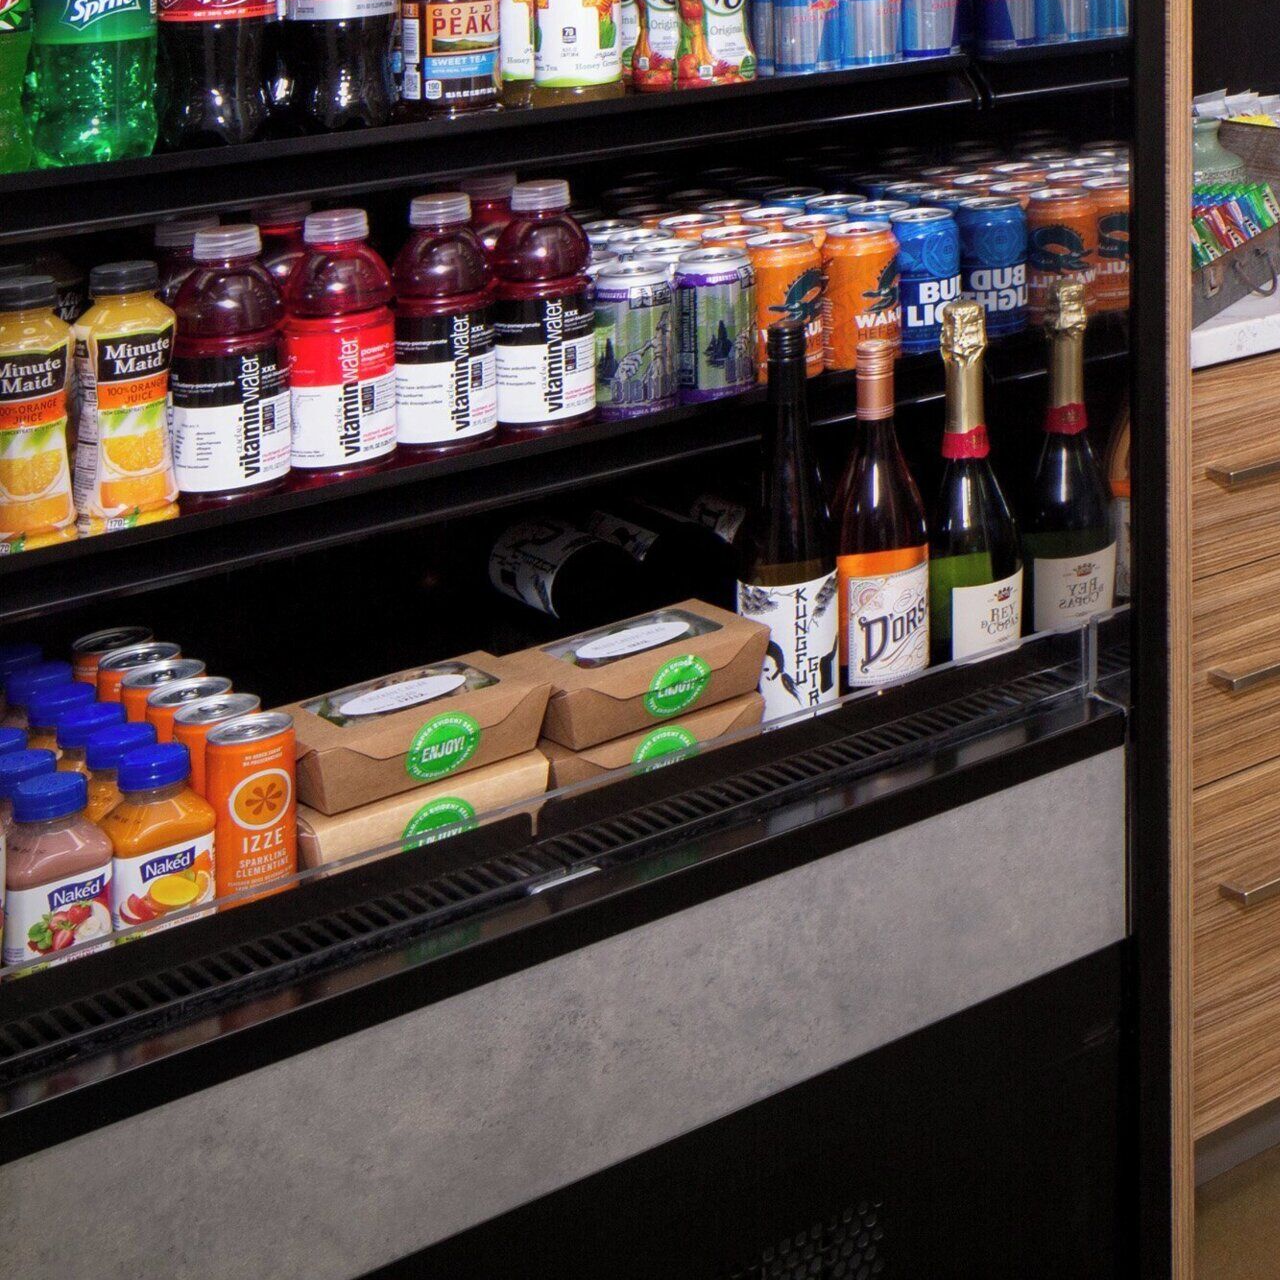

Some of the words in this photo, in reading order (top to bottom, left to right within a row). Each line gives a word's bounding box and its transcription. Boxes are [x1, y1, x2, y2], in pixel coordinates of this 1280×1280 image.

[432, 5, 492, 17] GOLD
[432, 14, 493, 37] PEAK
[710, 24, 742, 36] Original
[431, 56, 465, 66] SWEET
[468, 55, 488, 64] TEA
[104, 337, 170, 361] Minute
[113, 356, 164, 375] Maid
[1, 375, 56, 393] Maid
[126, 379, 167, 394] ORANGE
[124, 391, 152, 404] JUICE
[15, 411, 42, 423] JUICE
[991, 602, 1016, 622] REY
[421, 737, 464, 763] ENJOY!
[241, 829, 283, 854] IZZE
[239, 848, 287, 869] SPARKLING
